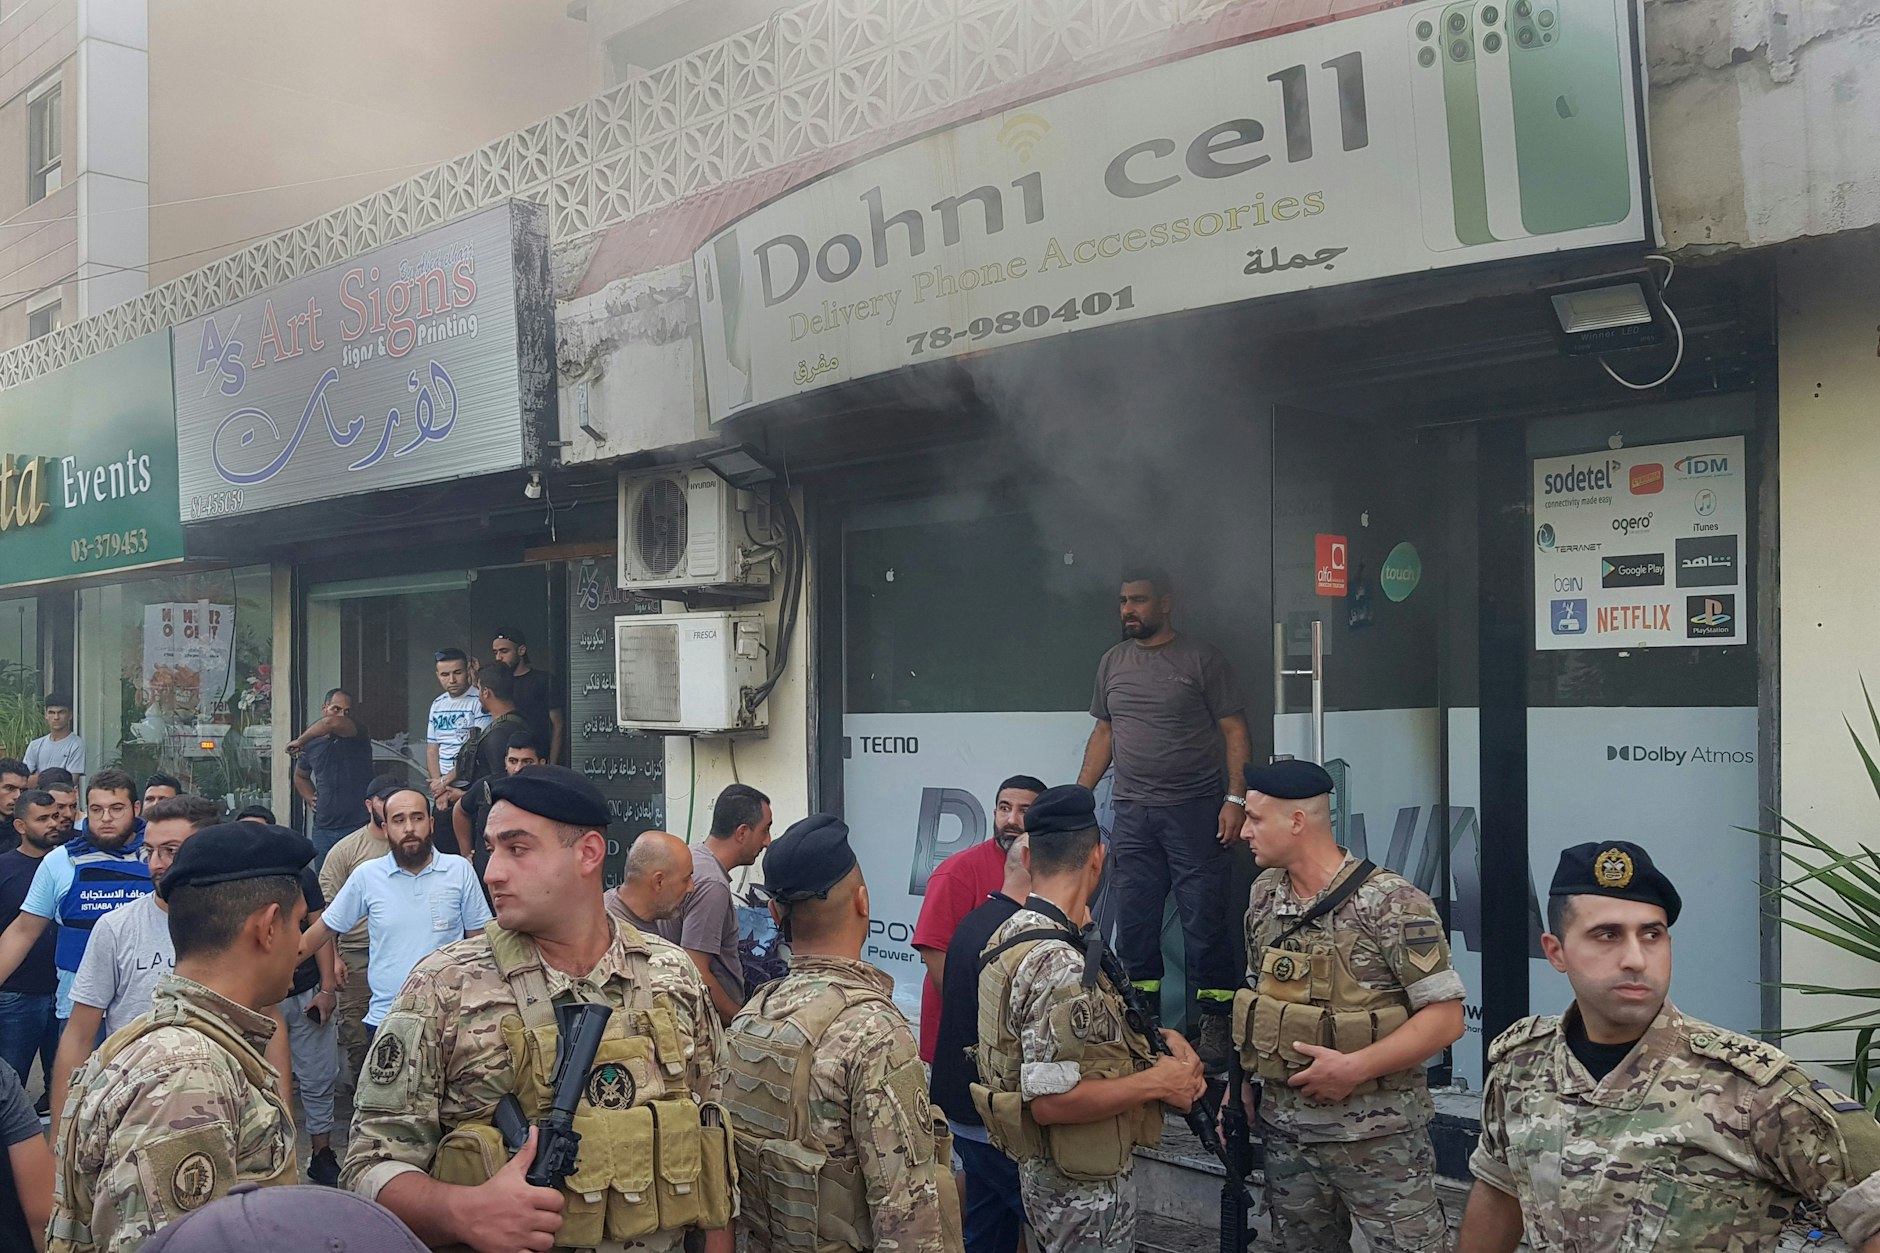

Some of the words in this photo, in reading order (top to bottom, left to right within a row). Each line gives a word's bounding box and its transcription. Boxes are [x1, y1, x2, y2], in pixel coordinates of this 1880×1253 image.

[753, 170, 1045, 309] Dohni
[1104, 51, 1369, 199] cell
[788, 288, 902, 342] Delivery
[911, 255, 1028, 306] Phone
[1038, 190, 1326, 274] Accessories
[1243, 245, 1349, 276] جملة
[251, 298, 325, 369] Art
[339, 257, 477, 358] Signs
[905, 285, 1136, 356] 78-980401
[1622, 326, 1640, 336] LED
[342, 341, 374, 369] Signs
[416, 314, 478, 347] Printing
[792, 353, 839, 387] مفرق
[61, 449, 152, 509] Events
[690, 480, 716, 490] HYUNDAI
[1544, 460, 1612, 494] sodetel
[1544, 498, 1580, 509] connectivity
[1581, 498, 1597, 507] made
[1598, 496, 1613, 507] easy
[1693, 523, 1719, 532] iTunes
[70, 527, 149, 562] 03-379453
[1555, 543, 1602, 553] TERRANET
[1618, 565, 1646, 577] Google
[1648, 563, 1664, 575] Play
[1681, 554, 1731, 568] شاهد
[1318, 566, 1332, 583] alfa
[1386, 566, 1415, 581] touch
[1597, 604, 1671, 633] NETFLIX
[693, 630, 717, 640] FRESCA
[1693, 626, 1729, 635] PlayStation
[859, 736, 919, 754] TECNO
[1633, 745, 1687, 766] Dolby
[1691, 746, 1754, 764] Atmos
[607, 758, 618, 780] على
[619, 757, 636, 781] طباعة
[622, 800, 633, 822] على
[80, 889, 124, 901] الاستجابة
[81, 902, 112, 911] ISTIJABA
[868, 946, 915, 962] Power
